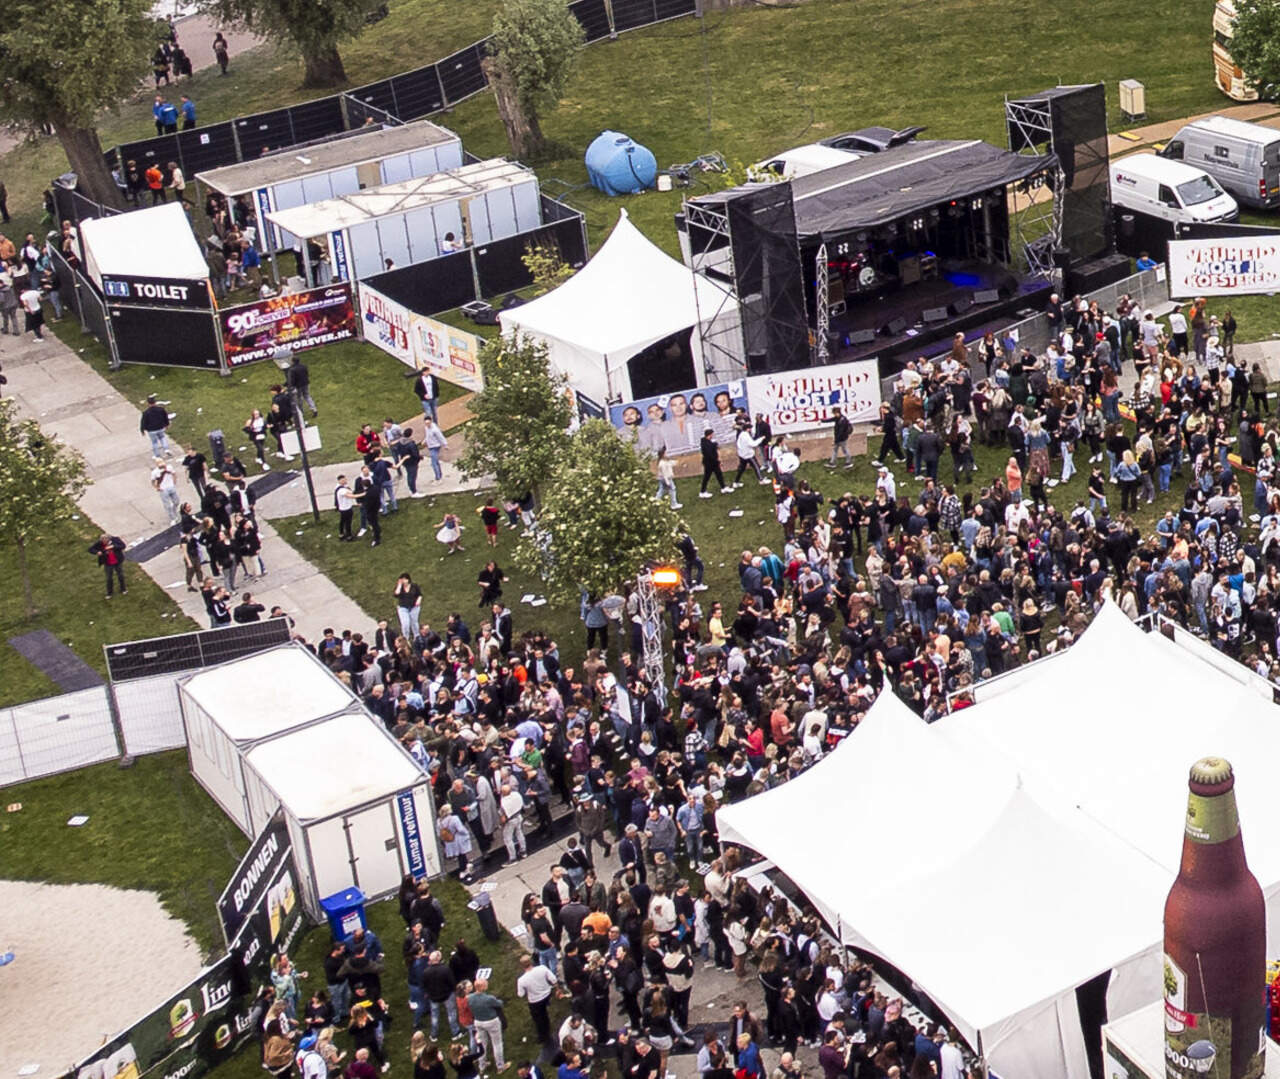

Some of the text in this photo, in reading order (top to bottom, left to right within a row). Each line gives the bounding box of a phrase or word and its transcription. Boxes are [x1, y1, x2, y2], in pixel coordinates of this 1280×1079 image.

[1186, 247, 1276, 263] VRIJHEID
[1194, 260, 1242, 275] MOET
[133, 283, 188, 301] TOILET
[766, 372, 869, 398] VRIJHEID
[776, 390, 832, 410] MOET
[402, 797, 423, 871] Lumar verhuur
[233, 832, 279, 913] BONNEN
